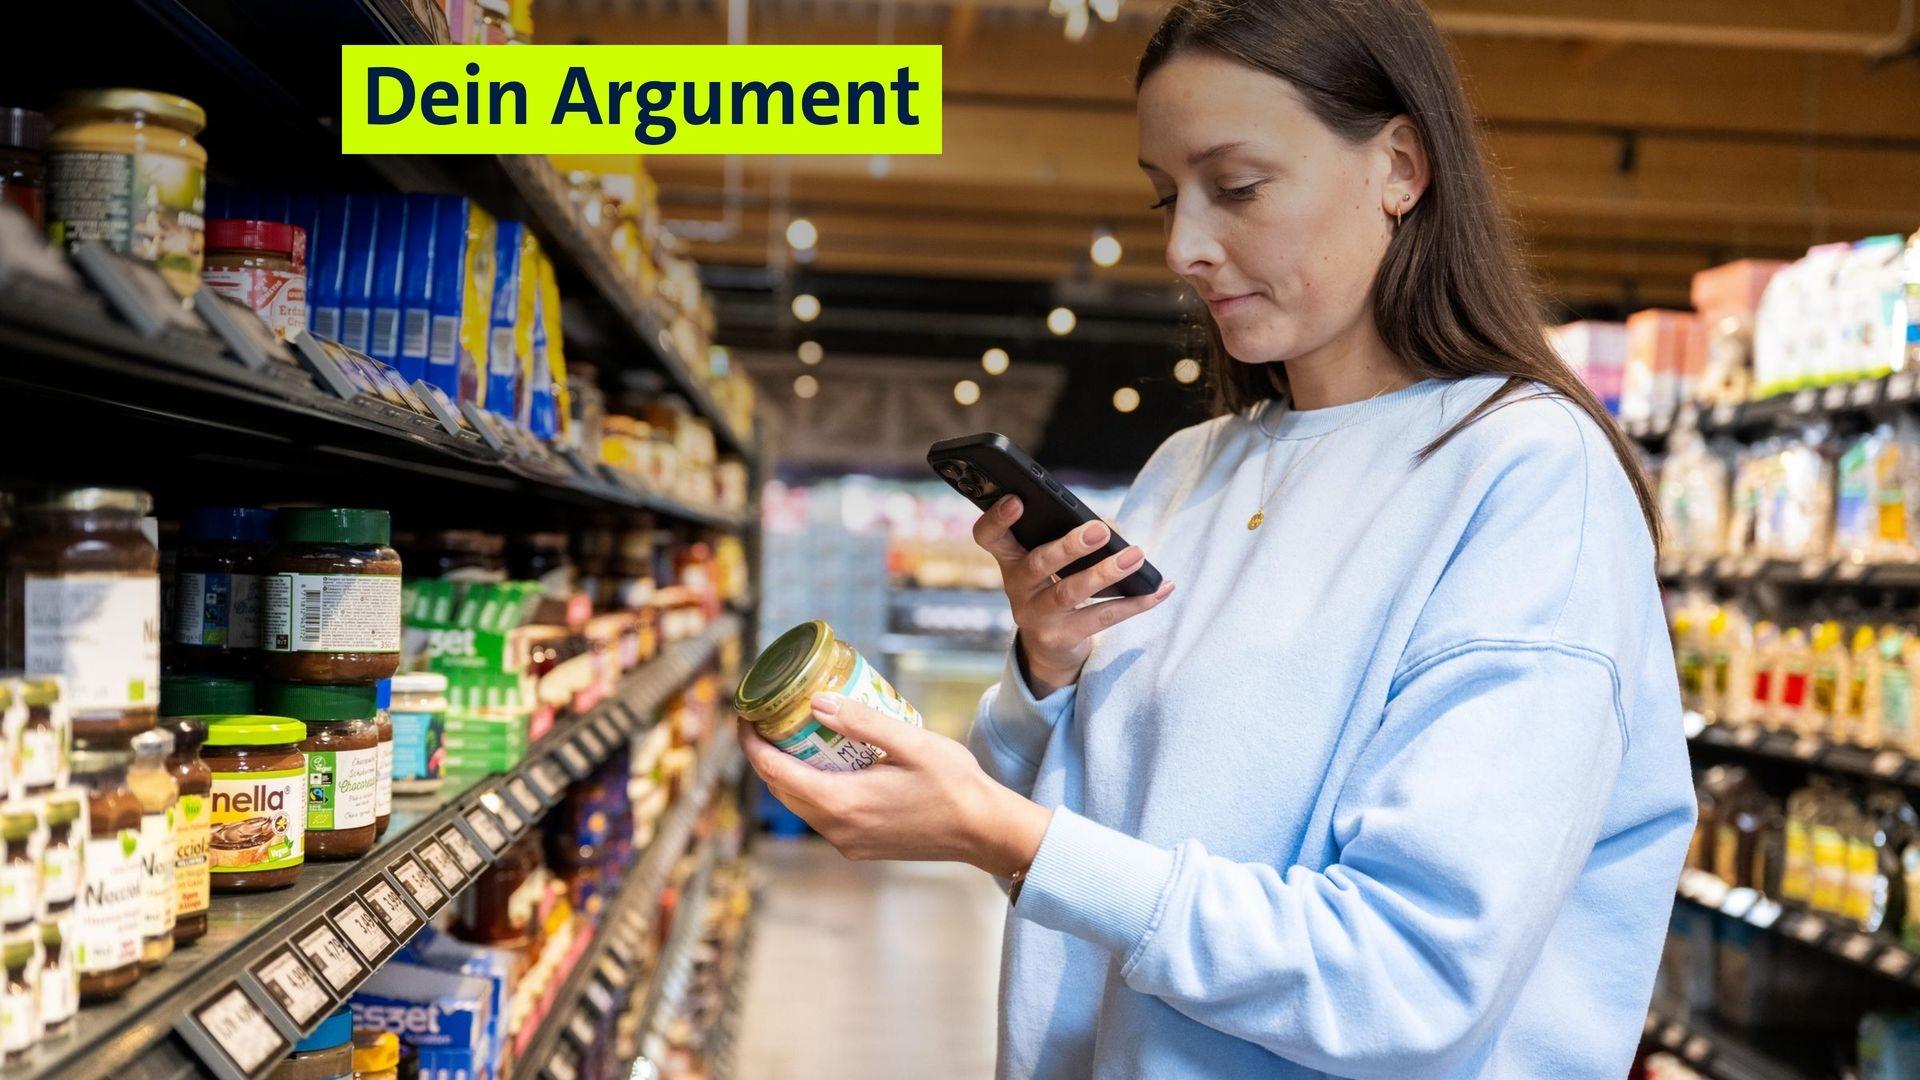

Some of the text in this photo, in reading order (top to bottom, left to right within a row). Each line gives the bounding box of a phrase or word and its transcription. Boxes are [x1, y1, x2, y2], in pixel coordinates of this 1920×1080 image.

[837, 741, 858, 763] MY
[382, 890, 402, 912] 3,99
[354, 912, 376, 935] 3,49
[323, 938, 346, 961] 4,79
